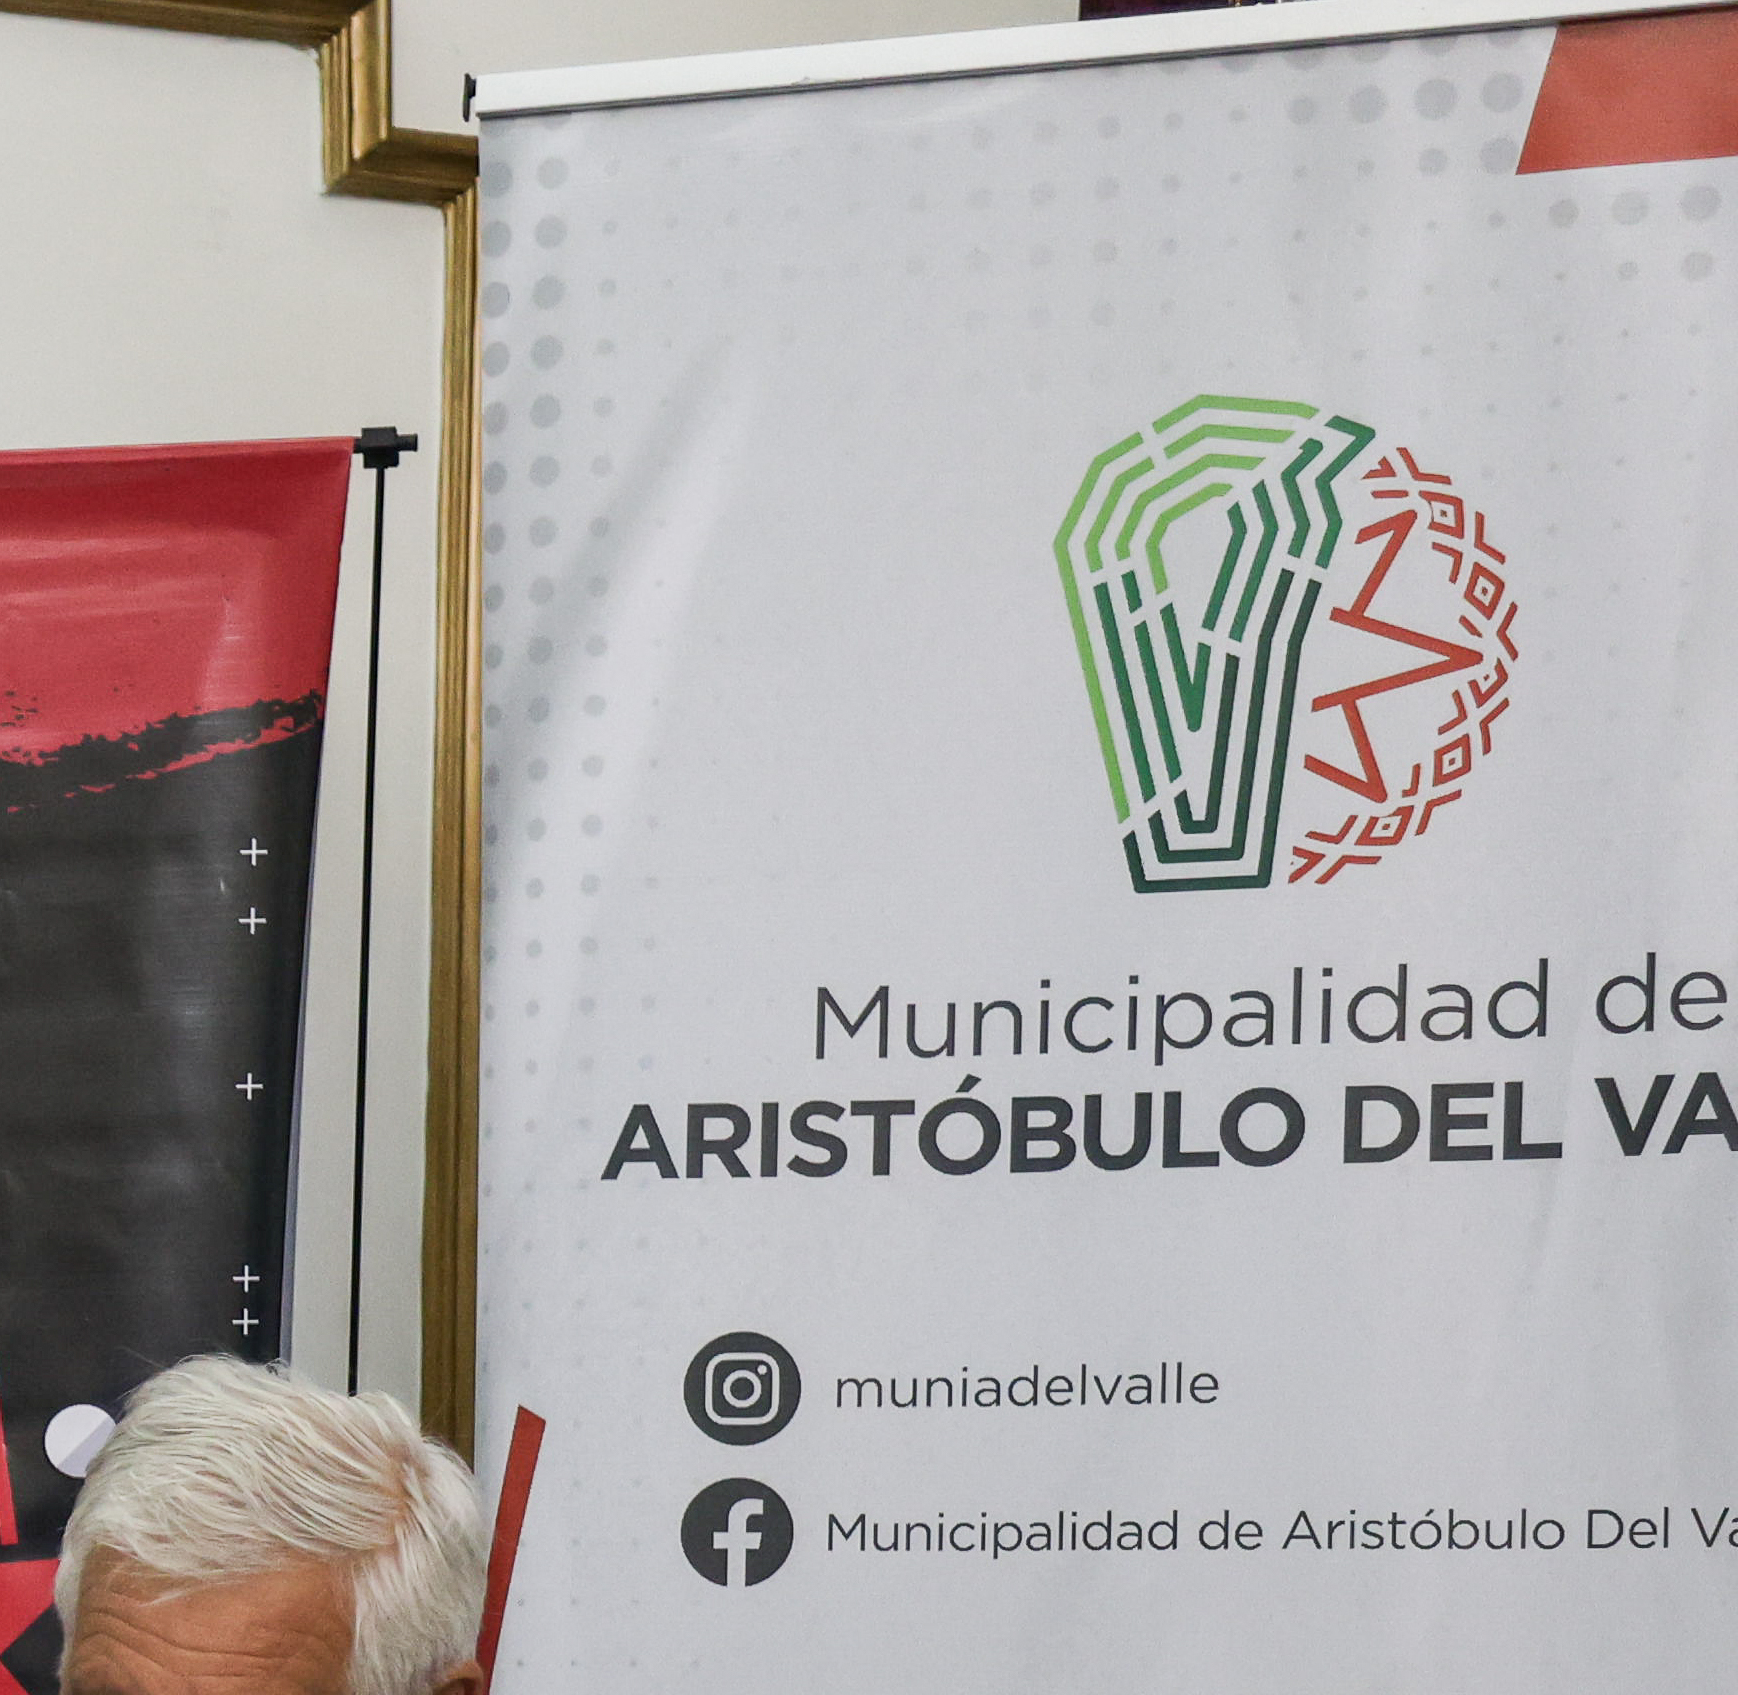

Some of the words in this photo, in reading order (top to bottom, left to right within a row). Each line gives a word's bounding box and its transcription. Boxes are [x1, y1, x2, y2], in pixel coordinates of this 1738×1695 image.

[815, 957, 1549, 1067] Municipalidad
[1595, 951, 1728, 1035] de
[600, 1074, 1306, 1181] ARISTÓBULO
[1343, 1080, 1563, 1164] DEL
[1593, 1071, 1738, 1157] VA
[836, 1361, 1220, 1408] muniadelvalle
[827, 1509, 1178, 1560] Municipalidad
[1198, 1509, 1264, 1551] de
[1281, 1507, 1566, 1550] Aristóbulo
[1586, 1506, 1670, 1549] Del
